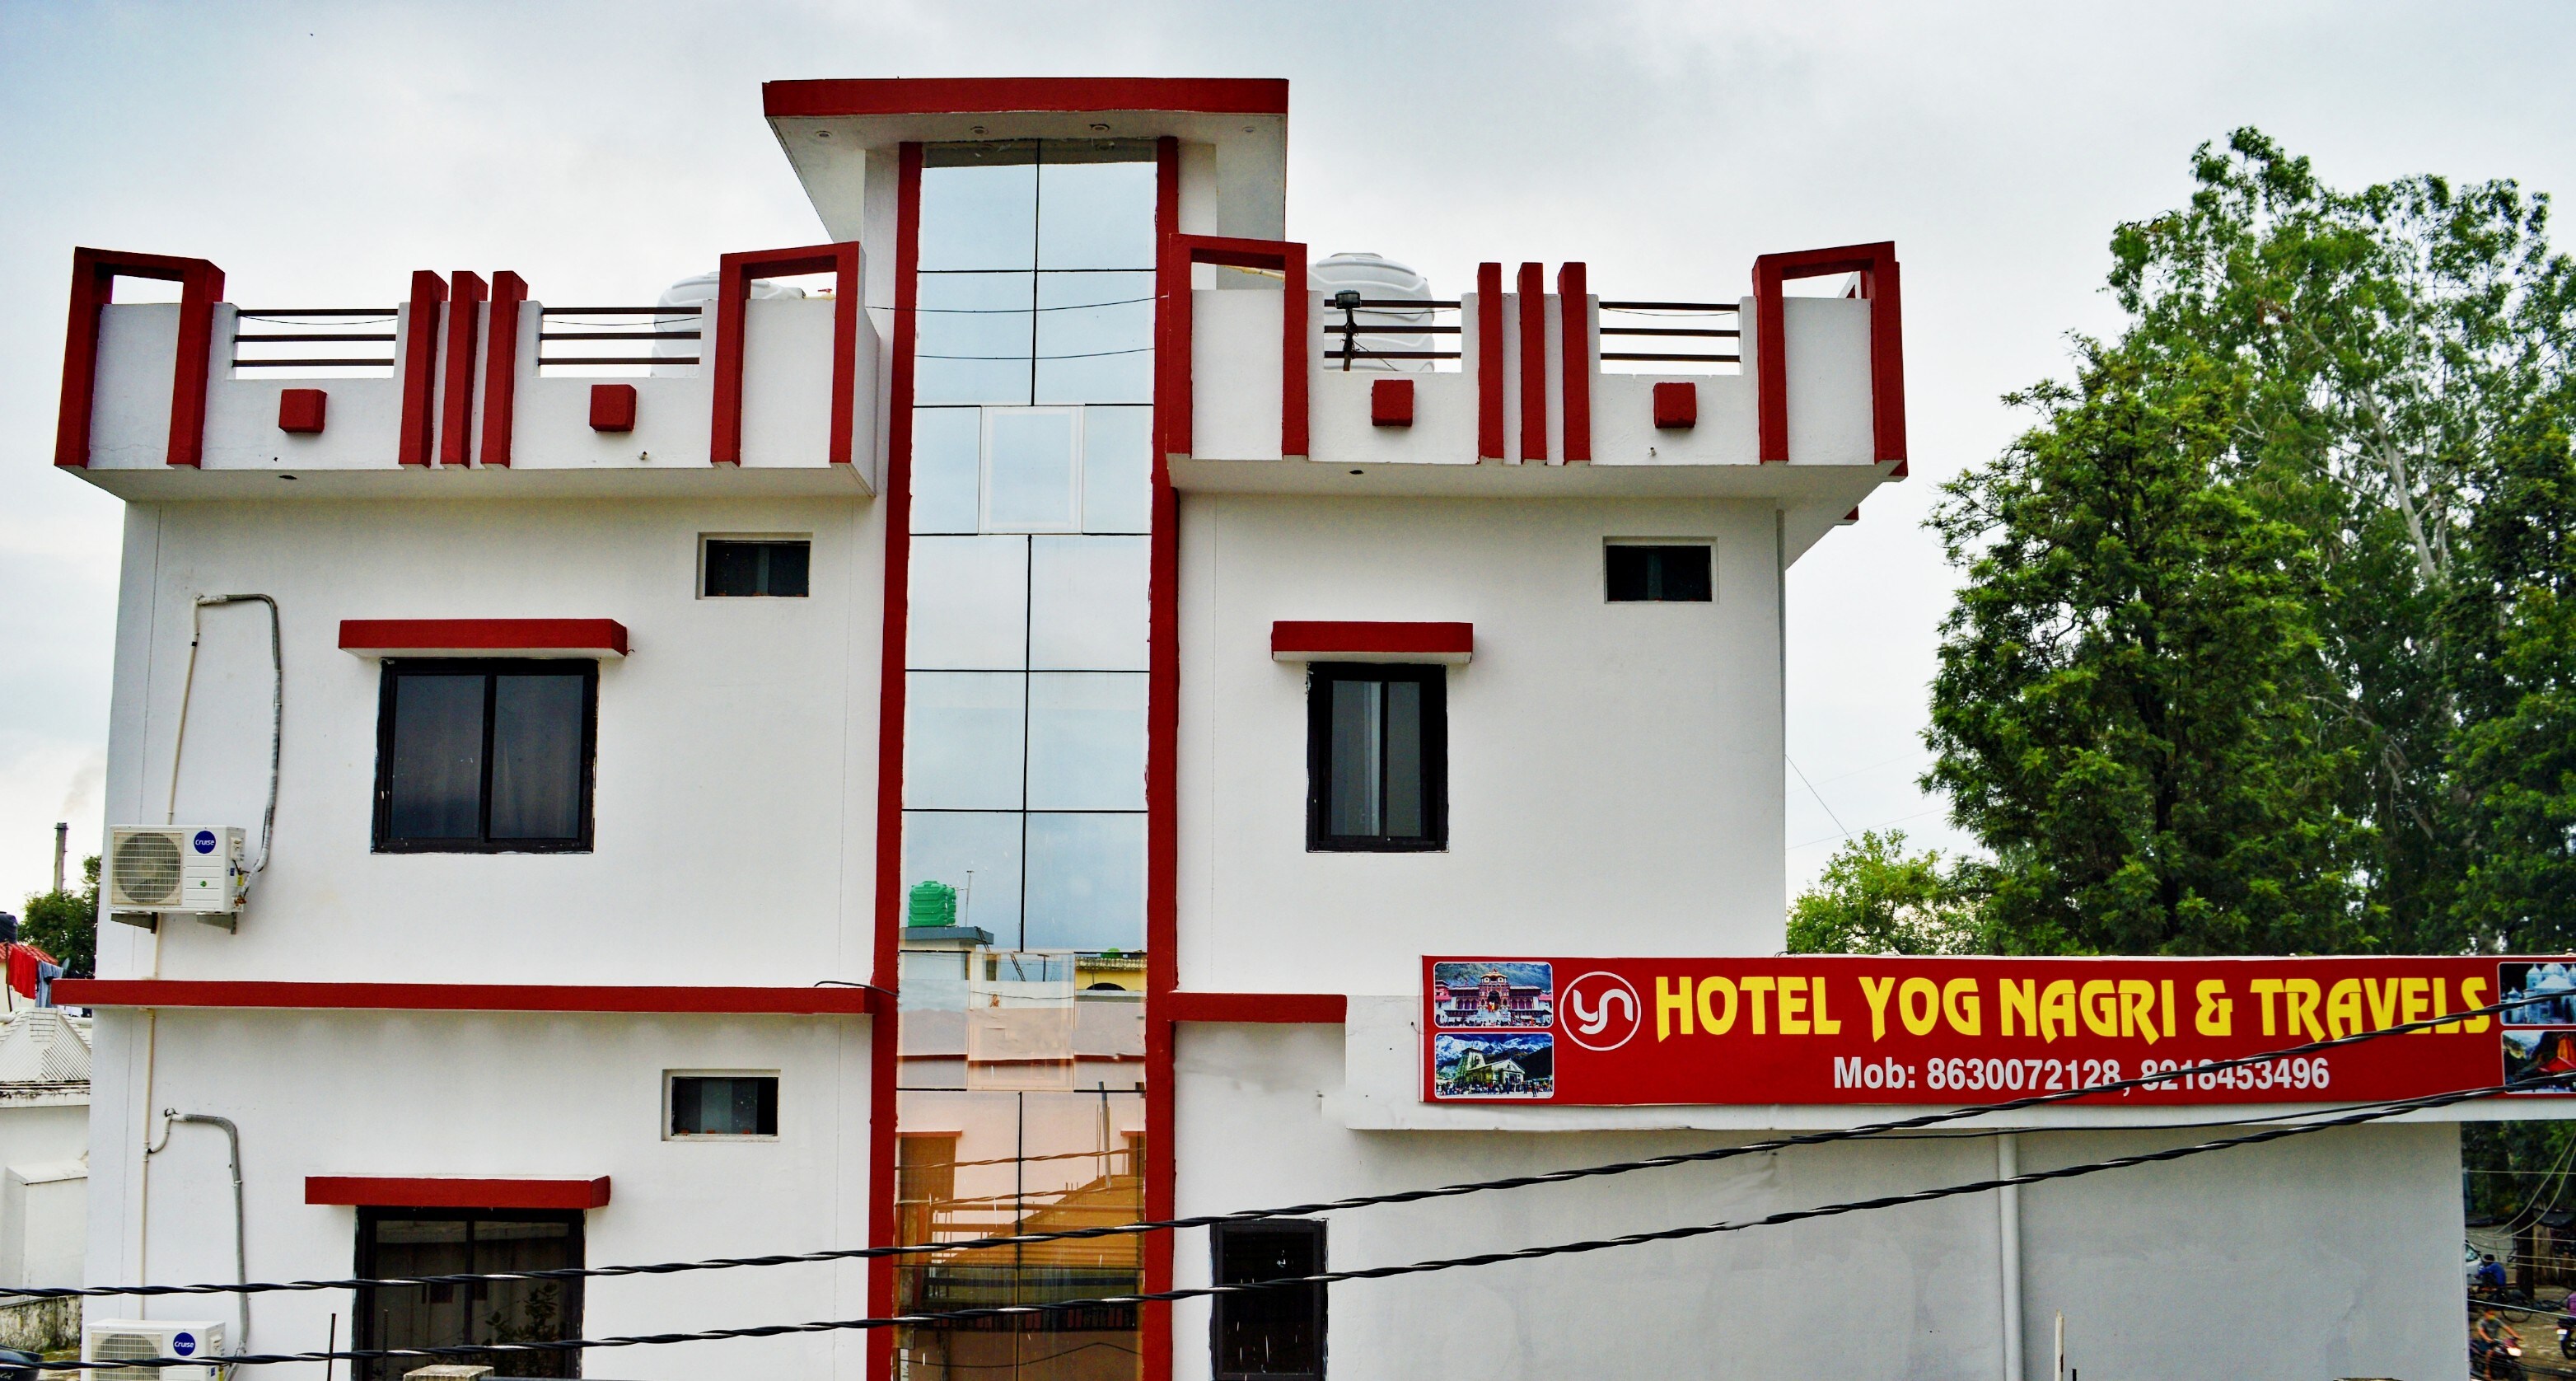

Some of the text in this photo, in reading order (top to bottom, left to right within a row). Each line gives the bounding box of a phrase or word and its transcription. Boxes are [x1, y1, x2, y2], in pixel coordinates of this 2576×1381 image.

[1656, 976, 2490, 1045] HOTEL YOG NAGRI & TRAVELS
[1834, 1056, 1915, 1089] Mob:
